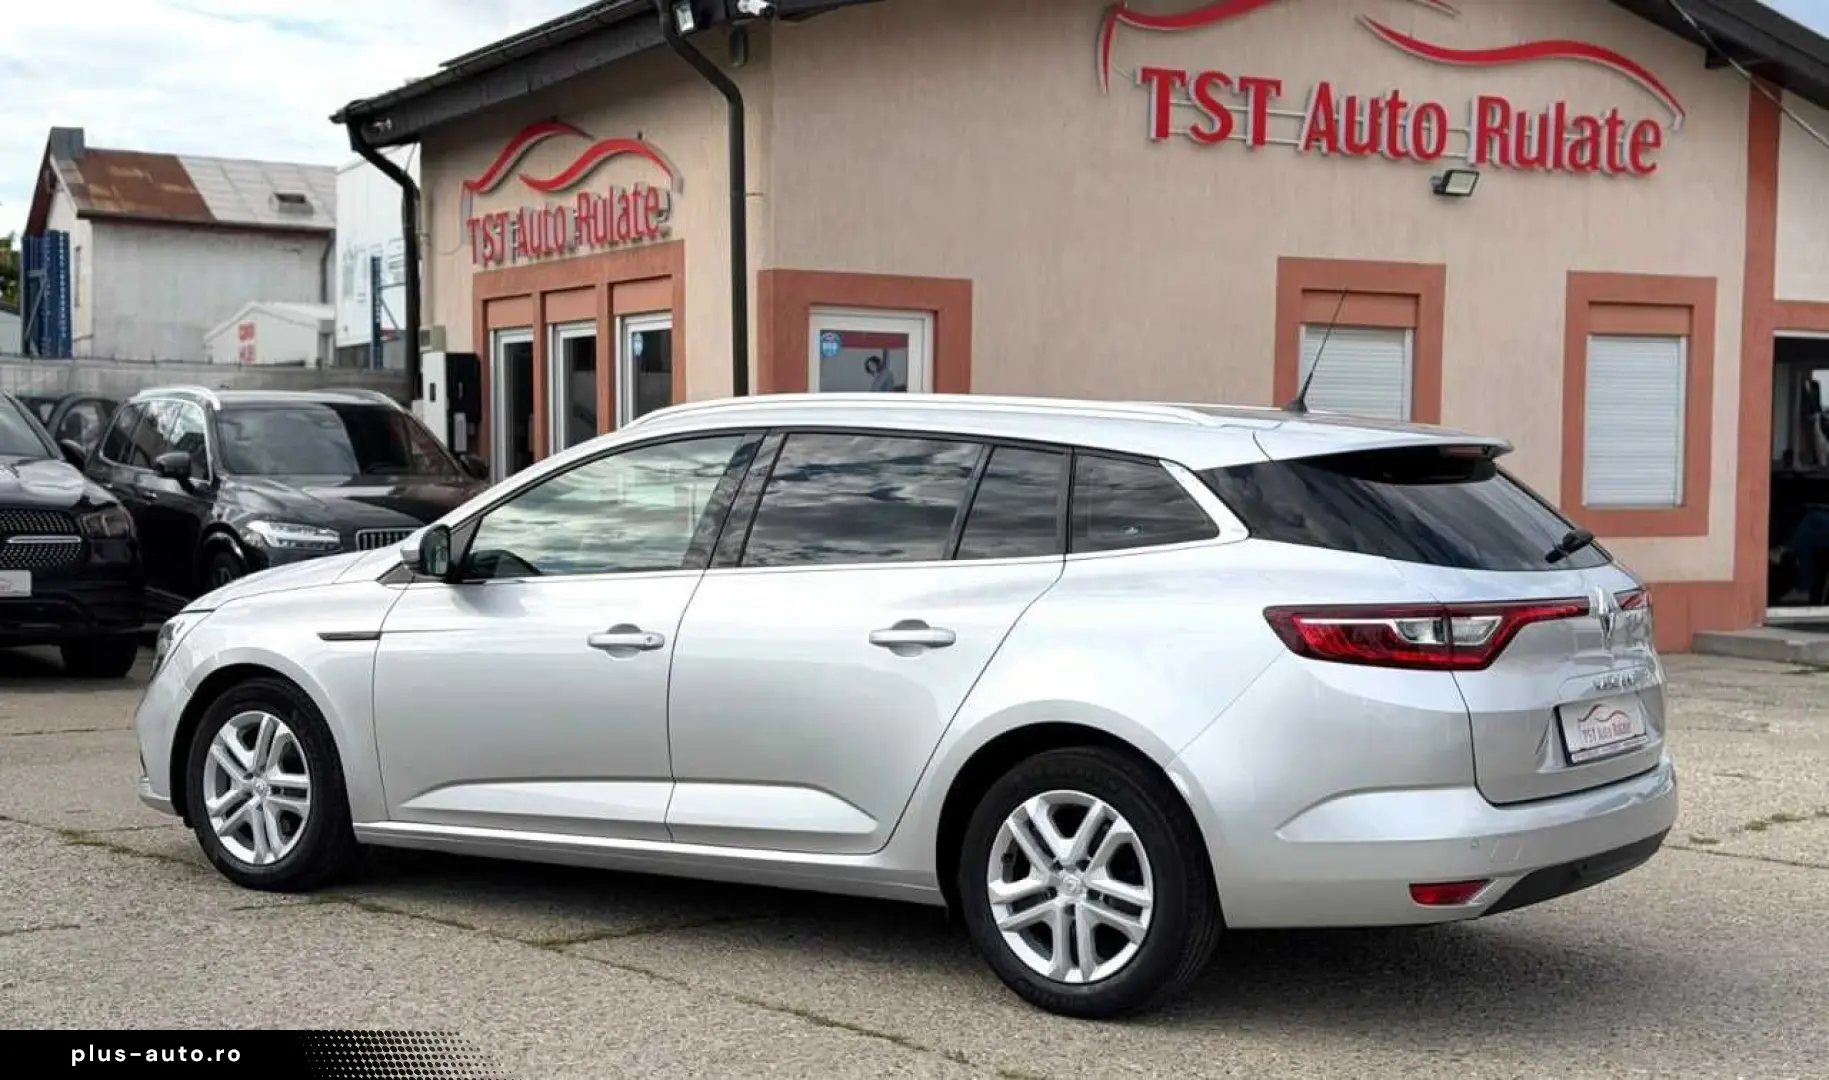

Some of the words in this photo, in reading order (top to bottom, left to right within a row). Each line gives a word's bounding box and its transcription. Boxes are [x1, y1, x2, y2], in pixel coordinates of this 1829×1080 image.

[1138, 66, 1282, 147] TST
[1302, 80, 1448, 162] Auto
[1472, 94, 1663, 176] Rulate
[466, 211, 509, 266] TST
[516, 204, 566, 258] Auto
[575, 183, 661, 246] Rulate
